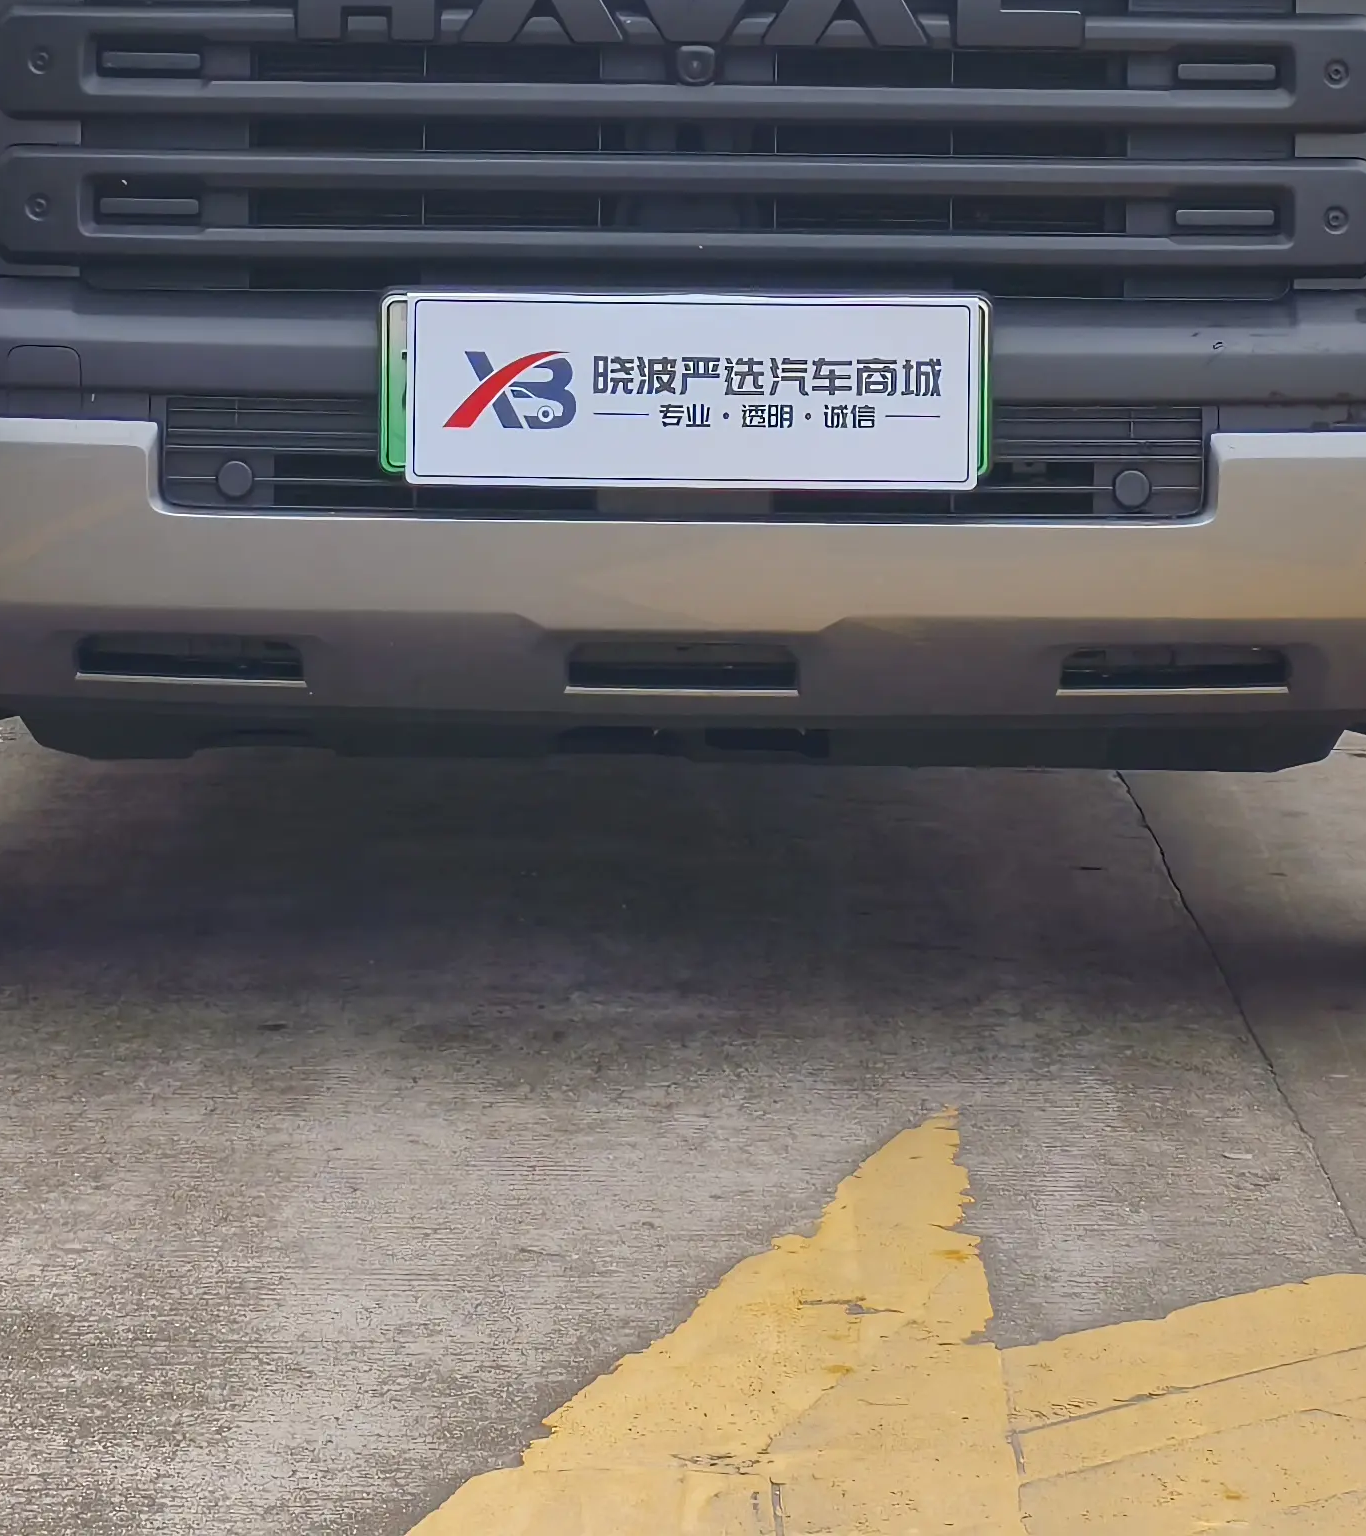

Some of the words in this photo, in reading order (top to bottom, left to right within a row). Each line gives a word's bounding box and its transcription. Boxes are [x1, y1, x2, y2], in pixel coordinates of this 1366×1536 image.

[592, 355, 943, 397] 晓波严选汽车商城
